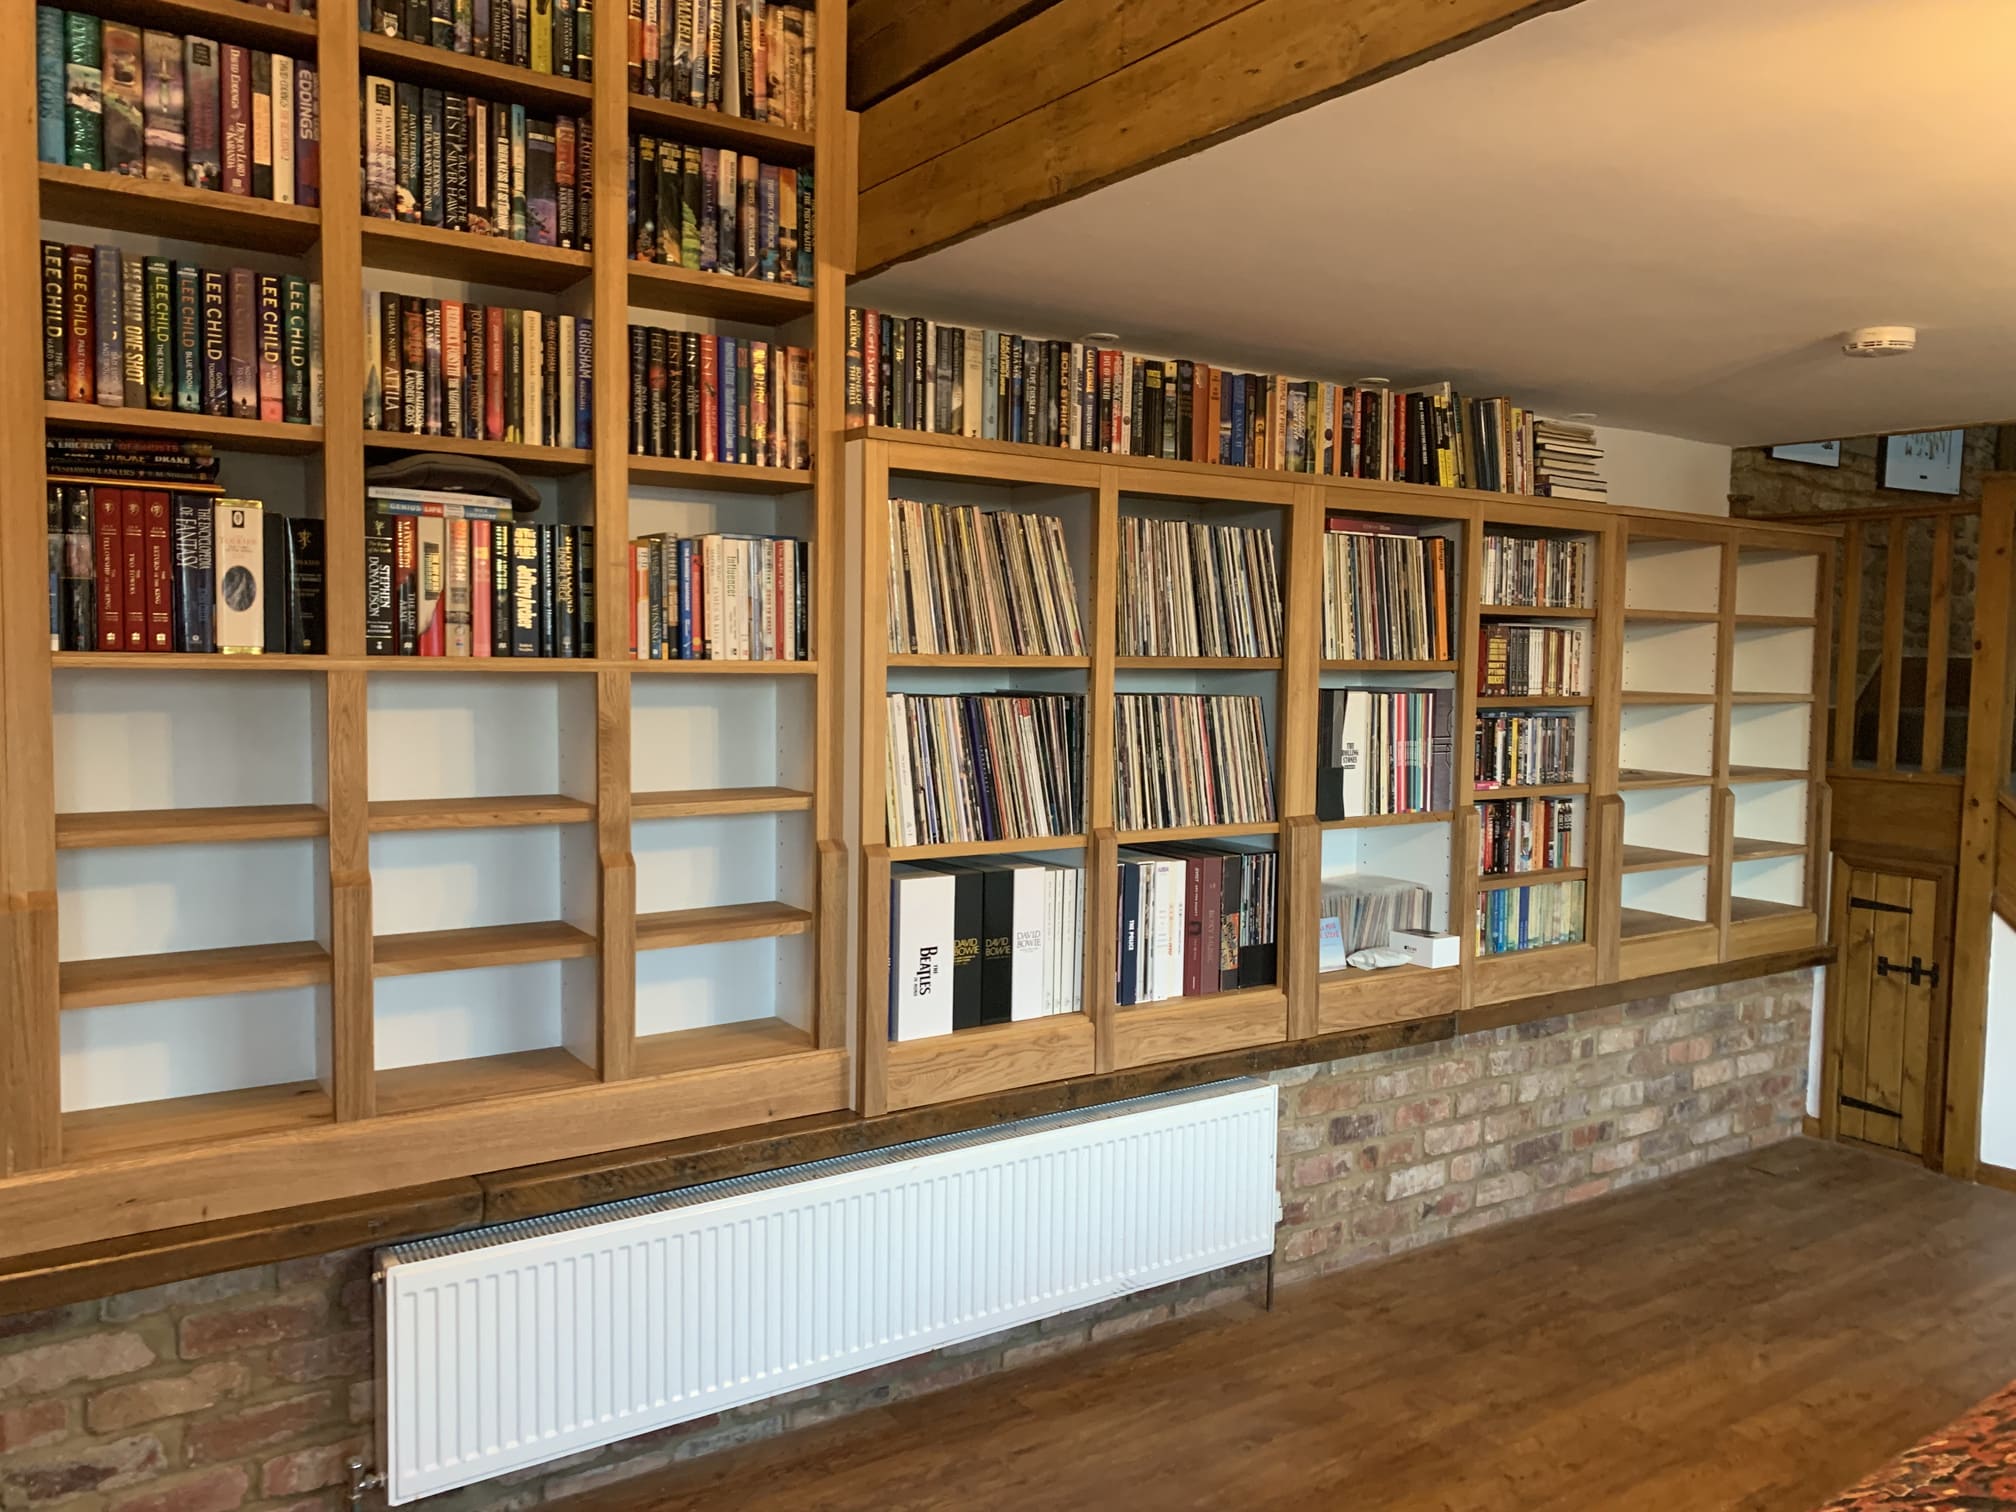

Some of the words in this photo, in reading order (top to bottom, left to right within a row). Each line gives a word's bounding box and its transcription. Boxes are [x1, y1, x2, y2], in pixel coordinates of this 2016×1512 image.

[708, 23, 722, 75] GEMMELL
[230, 49, 241, 81] DAVID
[230, 82, 243, 129] EDDINGS
[299, 69, 313, 140] EDDINGS
[401, 105, 409, 119] THE
[409, 114, 417, 141] DAVID
[424, 114, 432, 131] THE
[401, 121, 409, 162] SAPPHIRE
[424, 131, 432, 175] DIAMOND
[433, 131, 442, 158] DAVID
[409, 142, 417, 178] EDDINGS
[446, 150, 459, 185] SILVER
[458, 155, 467, 187] TALON
[581, 141, 593, 195] RIFTWAR
[433, 160, 442, 196] EDDINGS
[424, 176, 432, 212] THRONE
[446, 187, 459, 224] HAWK
[459, 189, 467, 202] OF
[459, 205, 468, 223] THE
[44, 245, 62, 279] LEE
[123, 261, 143, 282] LEE
[74, 265, 87, 291] LEE
[155, 276, 170, 300] LEE
[181, 279, 195, 305] LEE
[206, 273, 222, 305] LEE
[262, 276, 278, 309] LEE
[44, 282, 63, 338] CHILD
[123, 283, 144, 322] CHILD
[290, 281, 305, 312] LEE
[73, 294, 87, 336] CHILD
[155, 303, 170, 343] CHILD
[181, 307, 196, 348] CHILD
[388, 303, 398, 335] WILLIAM
[426, 308, 434, 350] ADAMS
[446, 305, 461, 344] FREDERICK
[472, 310, 482, 335] JOHN
[849, 309, 860, 348] IGGULDEN
[125, 325, 144, 351] ONE
[206, 308, 223, 361] CHILD
[263, 311, 280, 363] CHILD
[290, 315, 305, 367] CHILD
[547, 319, 556, 341] JOHN
[46, 338, 54, 360] HARD
[55, 352, 63, 367] THE
[77, 339, 85, 355] PAST
[156, 344, 164, 358] THE
[185, 351, 194, 368] BLUE
[389, 338, 398, 362] NAPIER
[446, 345, 461, 377] FORSYTH
[471, 335, 484, 376] GRISHAM
[546, 341, 557, 373] GRISHAM
[578, 329, 592, 379] GRISHAM
[669, 335, 680, 366] FEIST
[46, 361, 55, 377] WAY
[125, 352, 145, 387] SHOT
[157, 358, 165, 388] SENTINEL
[186, 369, 195, 389] MOON
[208, 362, 216, 398] TOMORROW
[215, 371, 223, 389] GONE
[415, 371, 424, 391] JAMES
[868, 357, 878, 385] STAR
[1060, 352, 1069, 386] BOLD
[385, 366, 399, 411] ATTILA
[405, 376, 415, 404] ANDREW
[672, 380, 681, 406] KING
[1029, 386, 1037, 415] CUSSLER
[405, 405, 415, 427] GROSS
[414, 391, 424, 427] PATTERSON
[1060, 389, 1069, 436] STRIKE
[1235, 409, 1243, 438] RAMA
[1279, 418, 1287, 437] FIRE
[154, 455, 191, 464] DRAKE
[180, 506, 194, 517] OF
[199, 508, 211, 521] THE
[390, 502, 422, 512] GENIUS
[424, 506, 444, 514] LIFE
[153, 545, 161, 571] RETURN
[176, 518, 198, 569] FANTASY
[199, 522, 212, 569] ENCYCLOPEDIA
[128, 553, 136, 568] TWO
[128, 569, 136, 596] TOWERS
[368, 556, 380, 617] DONALDSON
[380, 564, 391, 609] STEPHEN
[515, 565, 538, 599] Jeffrey
[559, 579, 567, 603] SIEGE
[727, 556, 738, 598] Influencer
[154, 588, 162, 605] KING
[408, 592, 416, 610] THE
[408, 611, 416, 631] LOST
[516, 599, 538, 630] Archer
[653, 604, 661, 642] WINNING
[1016, 930, 1041, 940] DAVID
[1207, 909, 1217, 934] ROXY
[954, 938, 978, 948] DAVID
[954, 946, 980, 956] BOWIE
[985, 937, 1009, 948] DAVID
[985, 946, 1012, 957] BOWIE
[1016, 939, 1041, 949] BOWIE
[1128, 931, 1136, 951] POLICE
[1207, 936, 1218, 963] MUSIC
[916, 946, 938, 996] BEATLES
